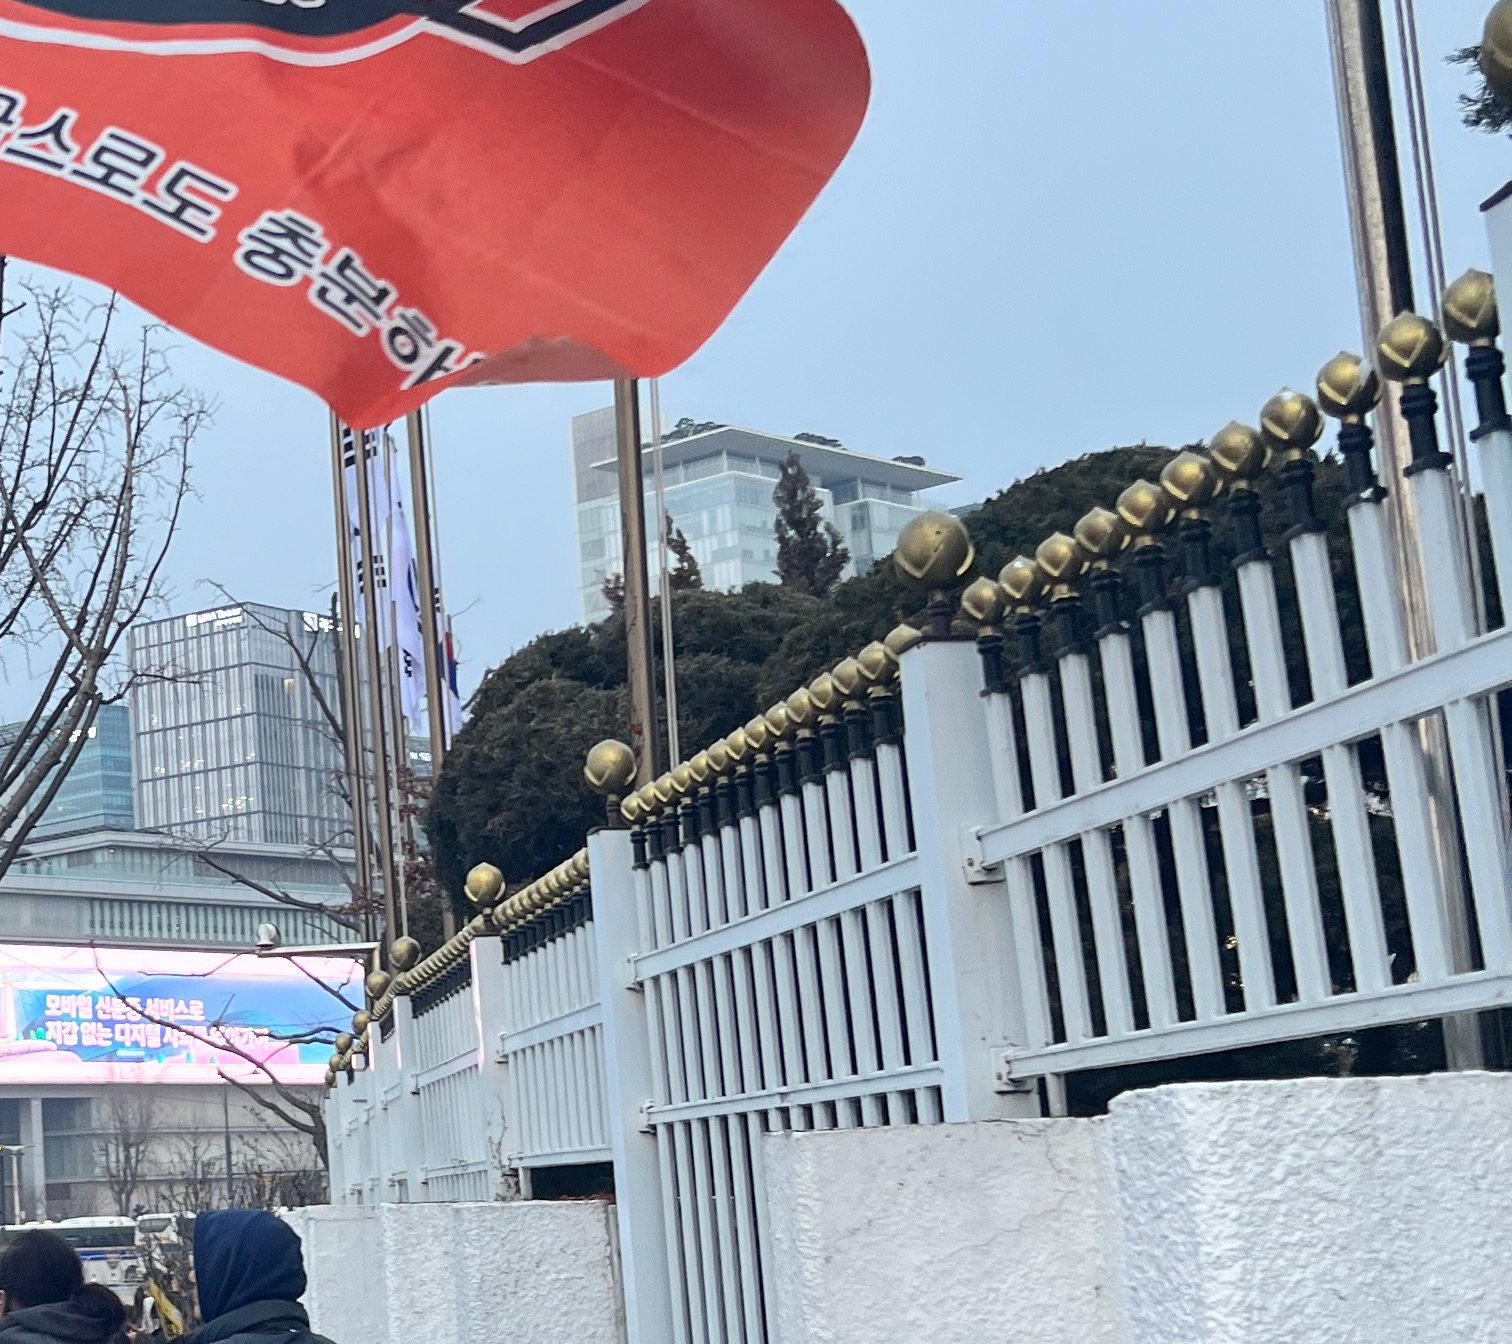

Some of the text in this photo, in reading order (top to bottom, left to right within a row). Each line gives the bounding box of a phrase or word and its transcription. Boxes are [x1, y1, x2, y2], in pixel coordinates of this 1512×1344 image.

[232, 208, 486, 391] 충분하
[45, 994, 92, 1019] 모바일
[145, 997, 206, 1023] 서비스로
[45, 1020, 80, 1046] 지갑
[81, 1020, 113, 1047] 없는
[114, 1022, 162, 1048] 디지털
